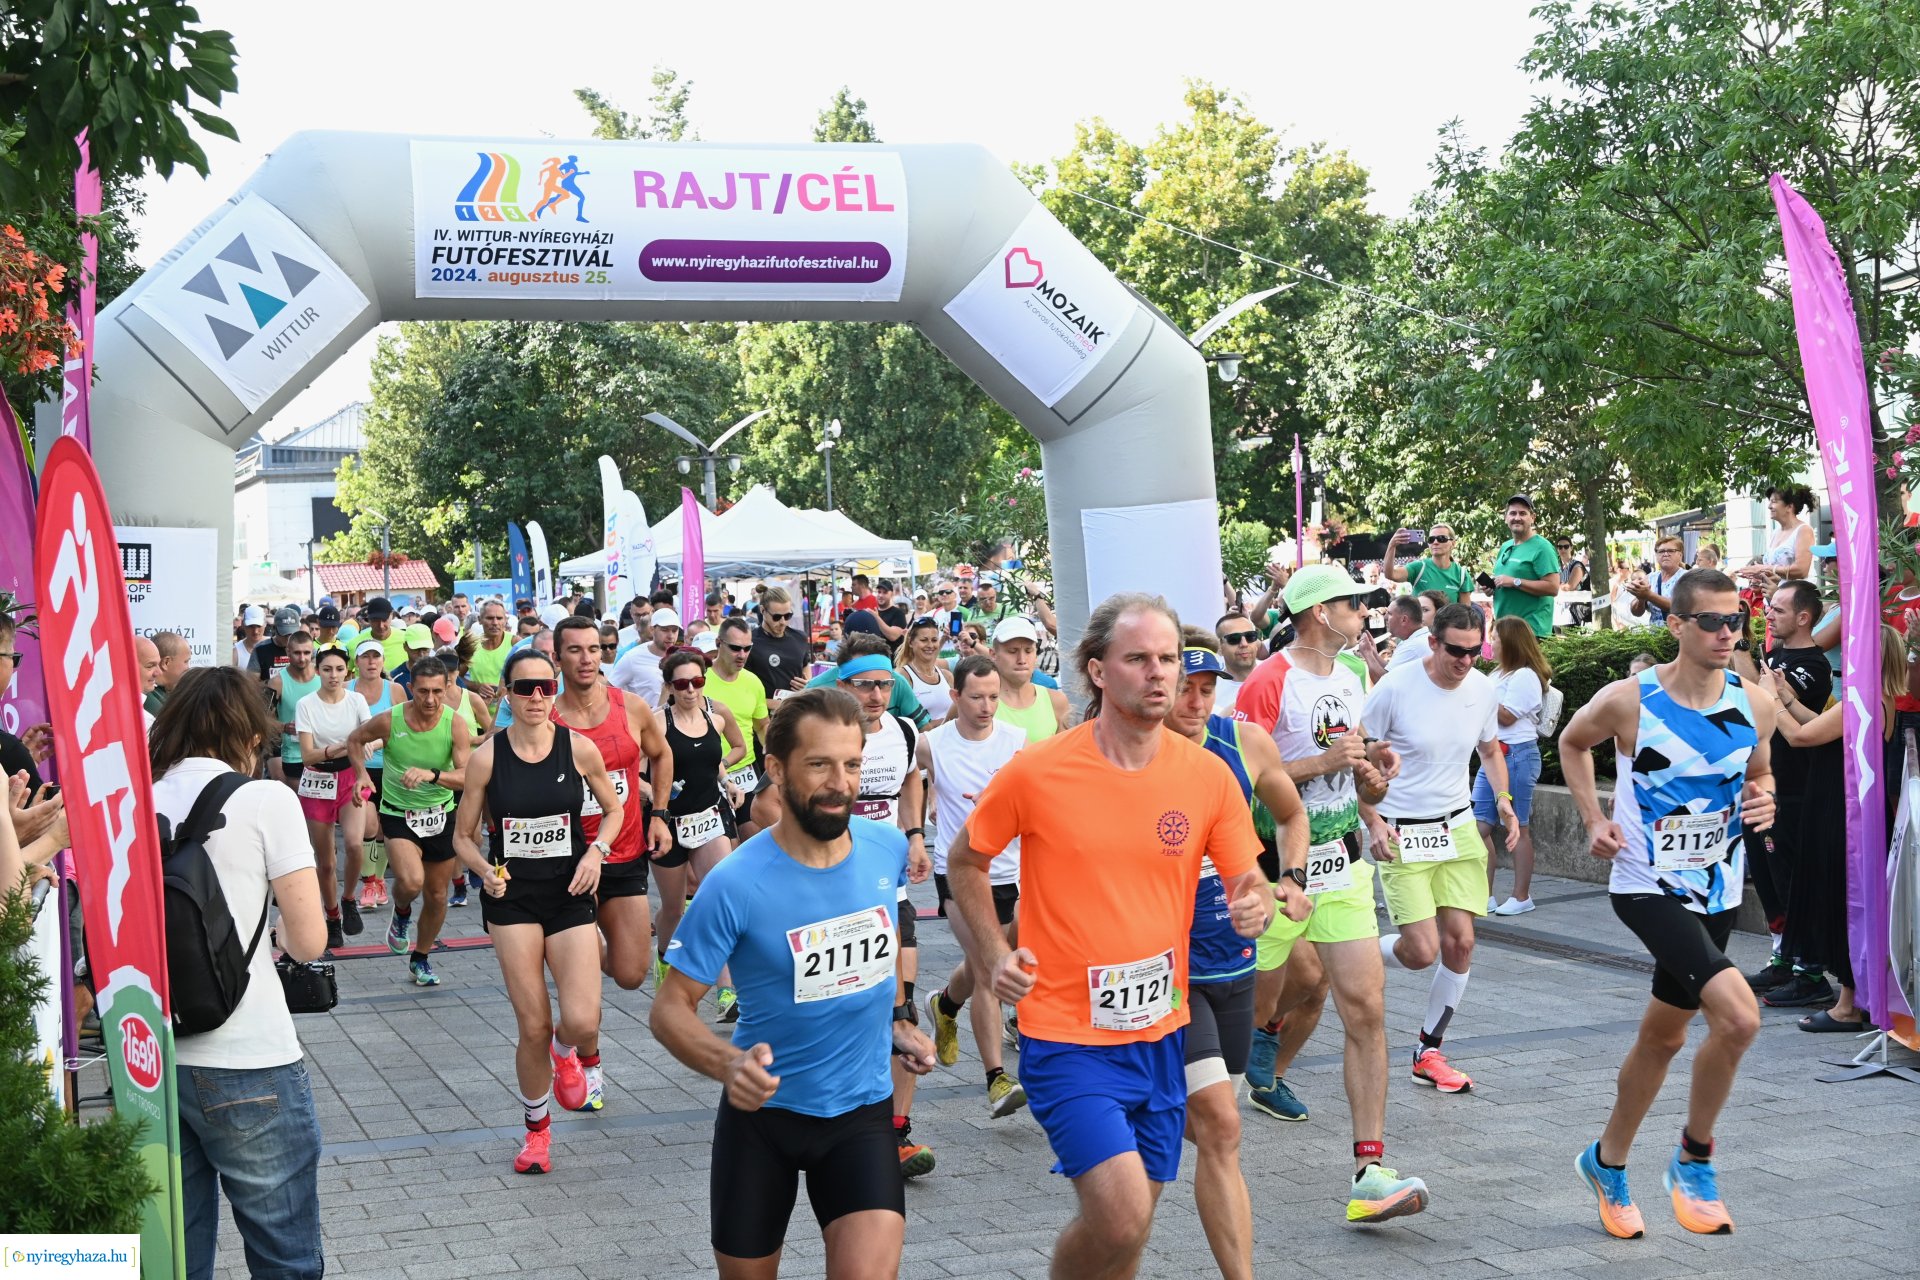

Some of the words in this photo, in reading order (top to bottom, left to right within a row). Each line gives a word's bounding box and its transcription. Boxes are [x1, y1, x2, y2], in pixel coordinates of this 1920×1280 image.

[633, 166, 895, 214] RAJT/CÉL
[461, 207, 470, 219] 1
[485, 207, 494, 219] 2
[508, 208, 518, 219] 3
[434, 229, 452, 241] IV.
[457, 228, 614, 245] WITTUR-NYÍREGYHÁZI
[431, 243, 614, 267] FUTÓFESZTIVÁL
[651, 254, 879, 270] www.nyiregyhazifutofesztival.hu
[431, 268, 482, 282] 2024.
[488, 270, 580, 285] augusztus
[585, 271, 612, 284] 25.
[1036, 280, 1105, 345] MOZAIK
[260, 306, 320, 361] WITTUR
[1075, 332, 1096, 353] med
[127, 584, 152, 593] OPE
[128, 594, 145, 603] HP
[301, 777, 334, 790] 21156
[860, 775, 896, 784] TÓFESZTIVÁL
[509, 828, 566, 845] 21088
[681, 817, 719, 839] 21022
[1403, 835, 1449, 849] 21025
[1661, 826, 1724, 851] 21120
[804, 933, 890, 978] 21112
[1099, 973, 1169, 1009] 21121
